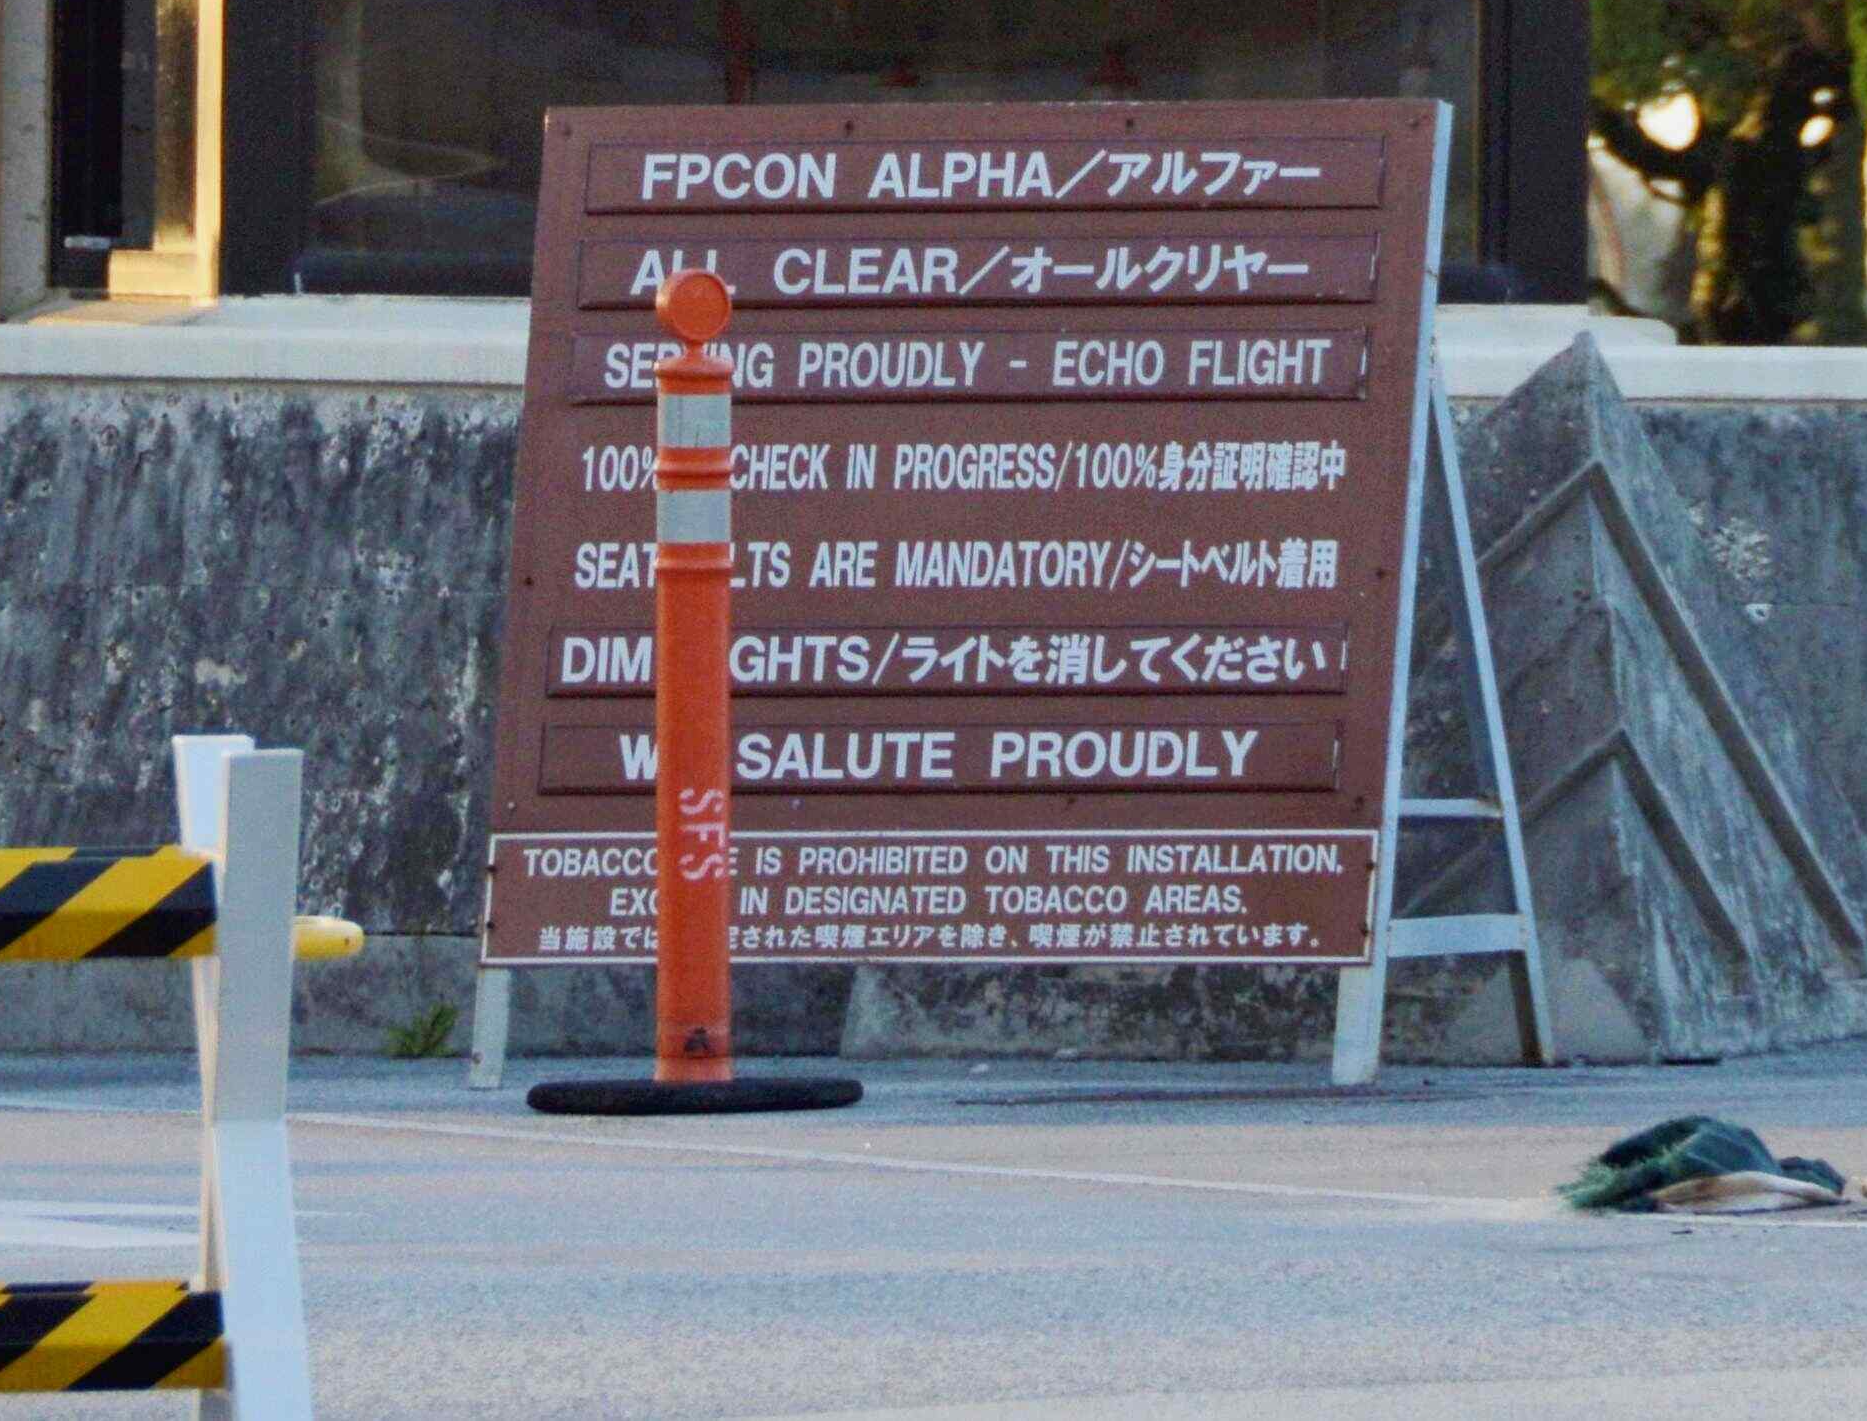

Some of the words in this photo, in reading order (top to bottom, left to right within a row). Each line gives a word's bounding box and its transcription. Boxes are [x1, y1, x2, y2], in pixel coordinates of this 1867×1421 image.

[638, 150, 839, 202] FPCON
[865, 146, 1323, 202] ALPHA/アルファー
[771, 242, 1311, 298] CLEAR/オールクリヤー
[603, 341, 776, 390] SENG
[795, 339, 986, 389] PROUDLY
[1050, 338, 1168, 387] ECHO
[1187, 336, 1335, 387] FLIGHT
[729, 442, 831, 492] CHECK
[845, 443, 879, 490] IN
[573, 540, 659, 590] SEAT
[730, 540, 793, 590] LTS
[807, 540, 879, 590] ARE
[559, 635, 655, 685] DIM
[729, 632, 1329, 686] GHTS/ライトを消してください
[617, 733, 659, 782] W
[735, 732, 957, 782] SALUTE
[988, 730, 1261, 780] PROUDLY
[677, 786, 729, 882] SFS
[754, 845, 783, 876] IS
[797, 844, 970, 876] PROHIBITED
[983, 844, 1029, 875] ON
[1045, 844, 1112, 875] THIS
[1125, 843, 1345, 876] INSTALLATION.
[738, 885, 770, 916] IN
[783, 885, 967, 916] DESIGNATED
[983, 884, 1129, 915] TOBACCO
[1143, 883, 1249, 915] AREAS.
